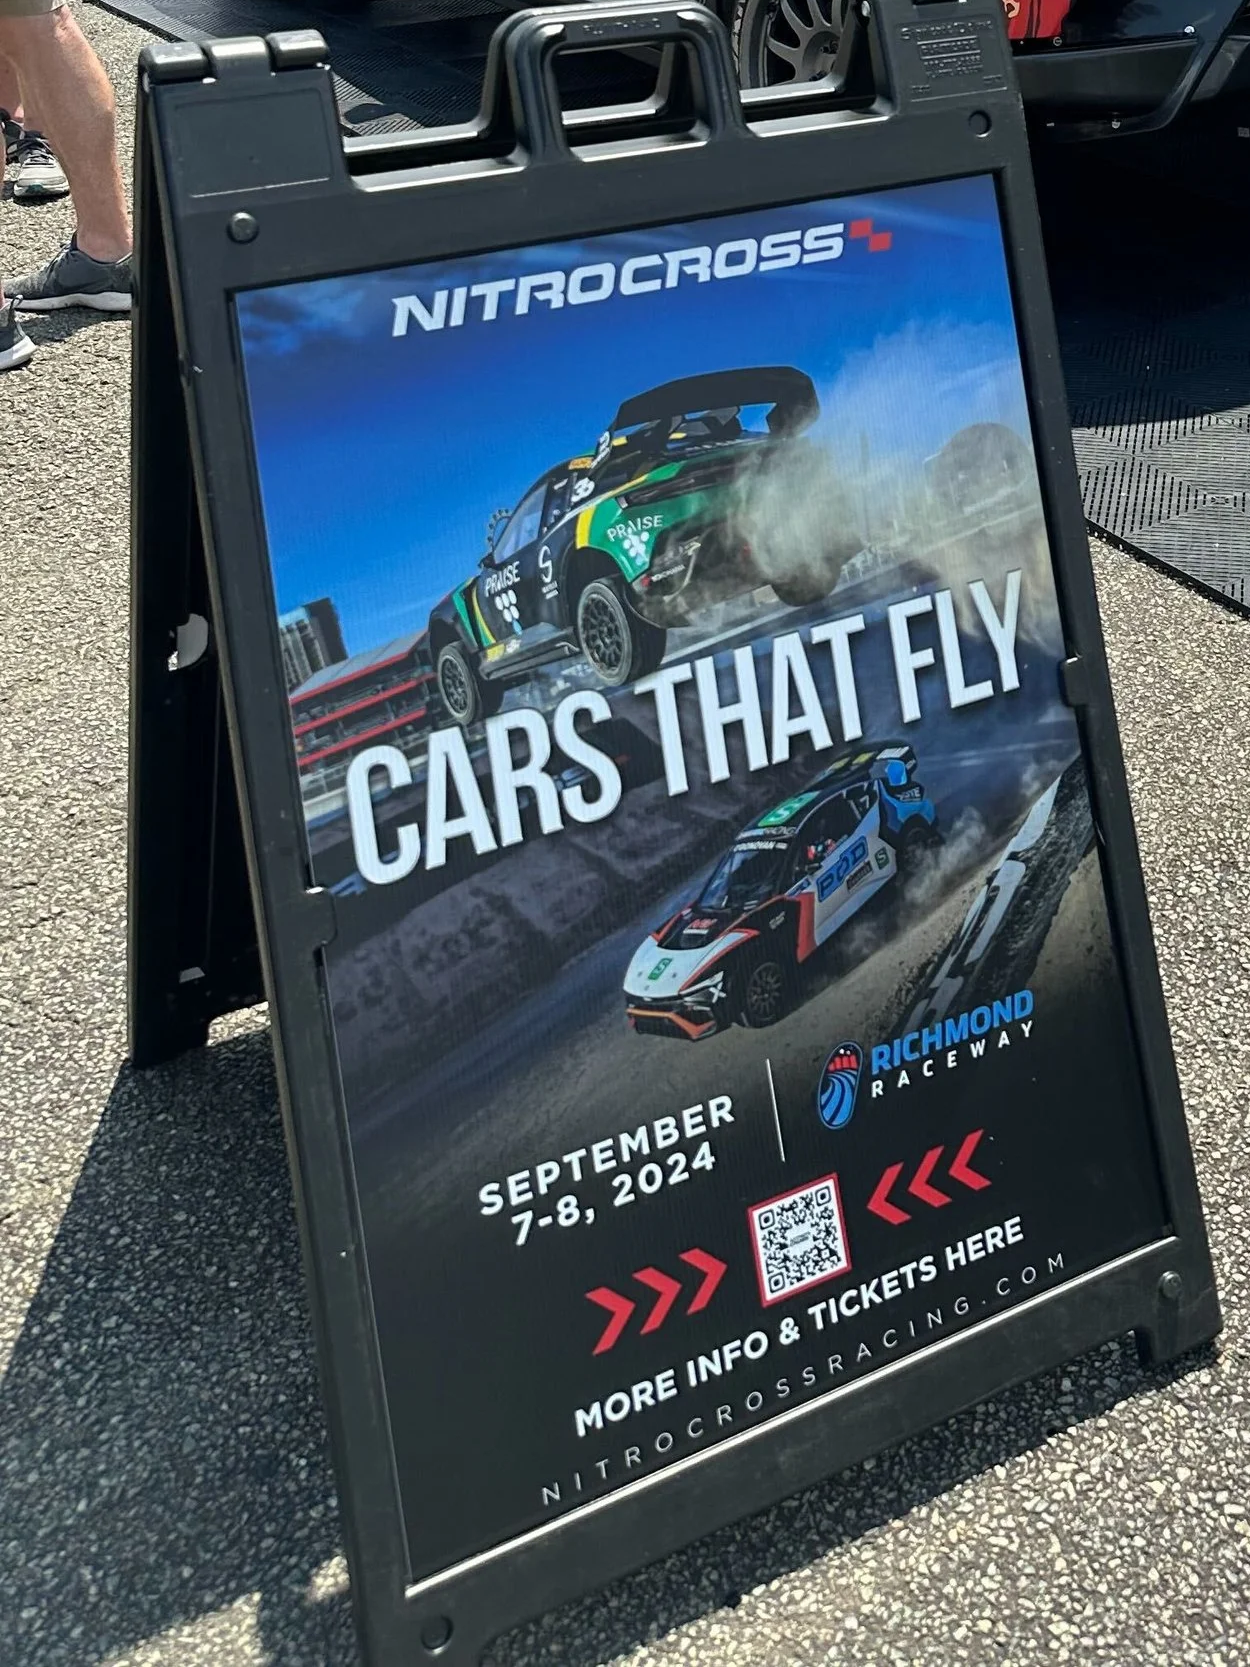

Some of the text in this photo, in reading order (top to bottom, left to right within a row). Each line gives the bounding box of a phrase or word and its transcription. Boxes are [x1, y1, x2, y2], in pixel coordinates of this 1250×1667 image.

[391, 222, 845, 337] NITROCROSS
[485, 560, 521, 597] PRAISE
[606, 514, 664, 542] PRAISE
[345, 569, 1022, 888] CARS THAT FLY
[871, 989, 1034, 1075] RICHMOND
[871, 1020, 1033, 1098] RACEWAY
[479, 1095, 735, 1216] SEPTEMBER
[511, 1141, 716, 1246] 7-8, 2024
[542, 1252, 1065, 1507] NITROCROSSRACING.COM
[574, 1216, 1025, 1437] MORE INFO & TICKETS HERE
